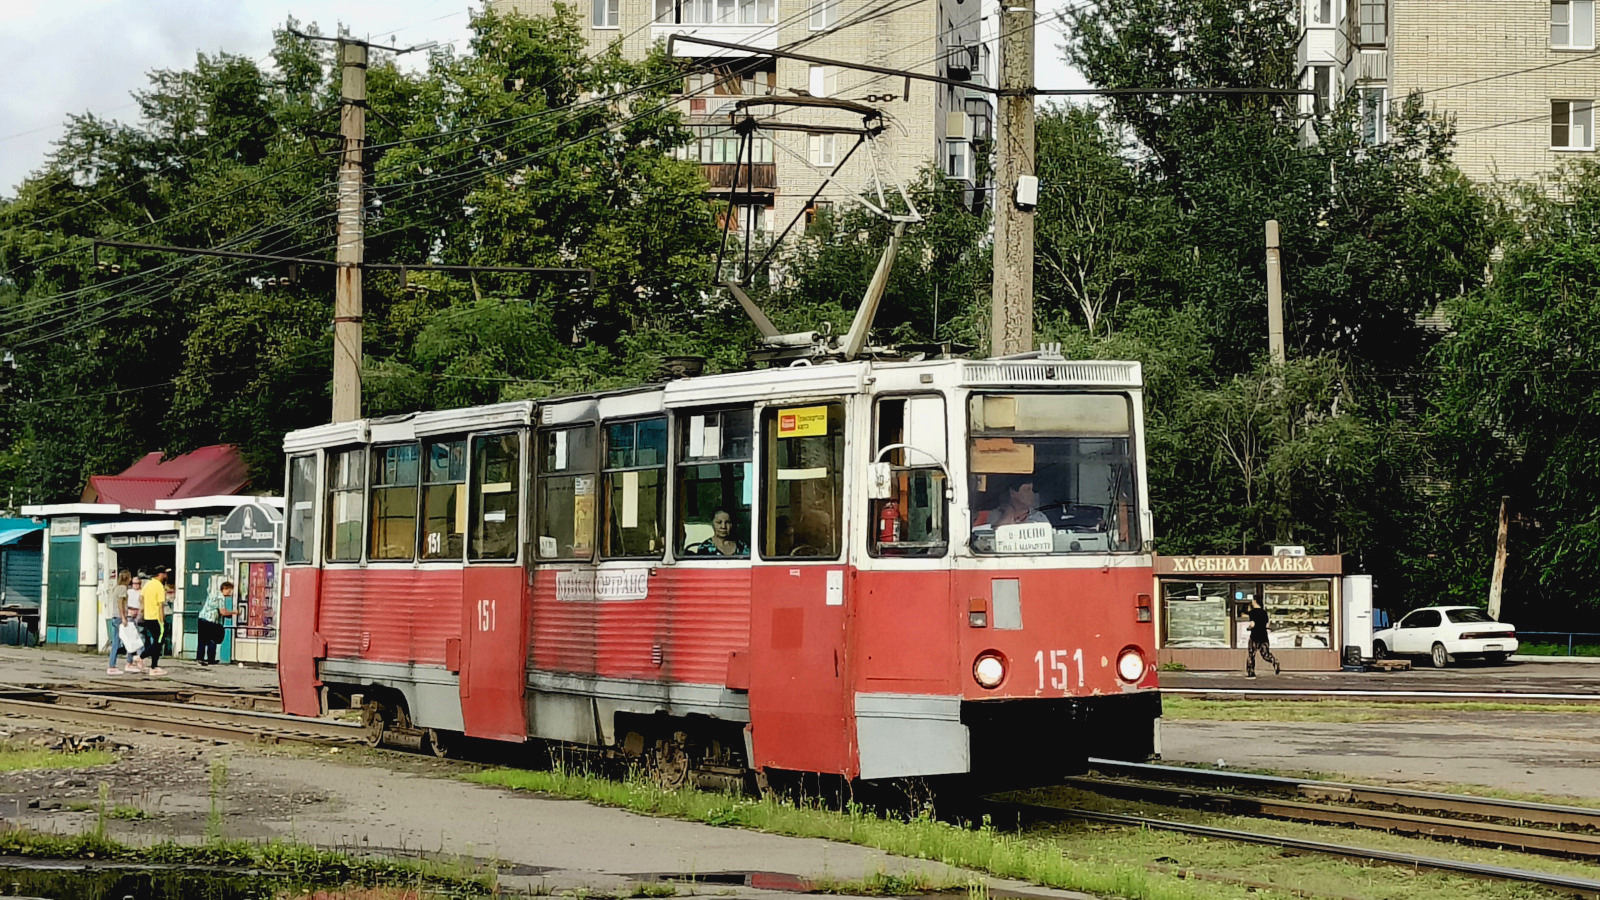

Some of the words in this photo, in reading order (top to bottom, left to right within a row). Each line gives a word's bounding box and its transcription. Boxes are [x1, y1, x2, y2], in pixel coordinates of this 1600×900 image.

[428, 532, 441, 554] 151
[1019, 527, 1046, 540] ДЕПО
[1172, 557, 1250, 572] ХЛЕБНАЯ
[1260, 557, 1315, 572] ЛАВКА
[477, 599, 496, 632] 151
[1034, 648, 1084, 690] 151
